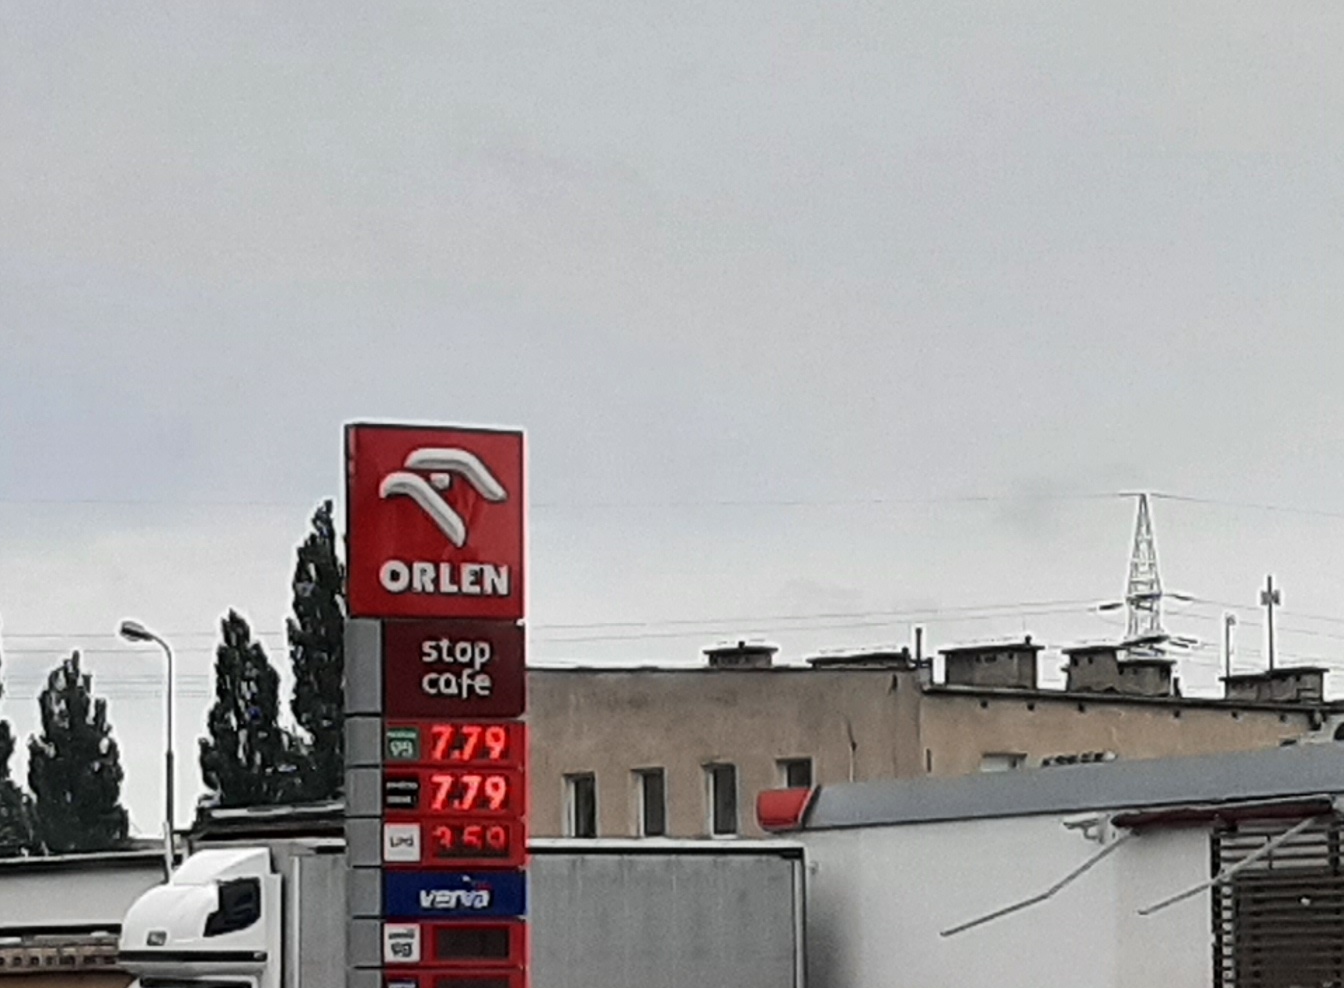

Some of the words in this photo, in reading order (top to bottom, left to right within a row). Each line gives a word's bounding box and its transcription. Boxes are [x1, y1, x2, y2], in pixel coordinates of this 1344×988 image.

[379, 559, 508, 595] ORLEN
[422, 637, 490, 671] stop
[422, 668, 492, 699] cafe
[431, 725, 506, 760] 7.79
[431, 774, 506, 810] 7.79
[419, 889, 490, 909] verva
